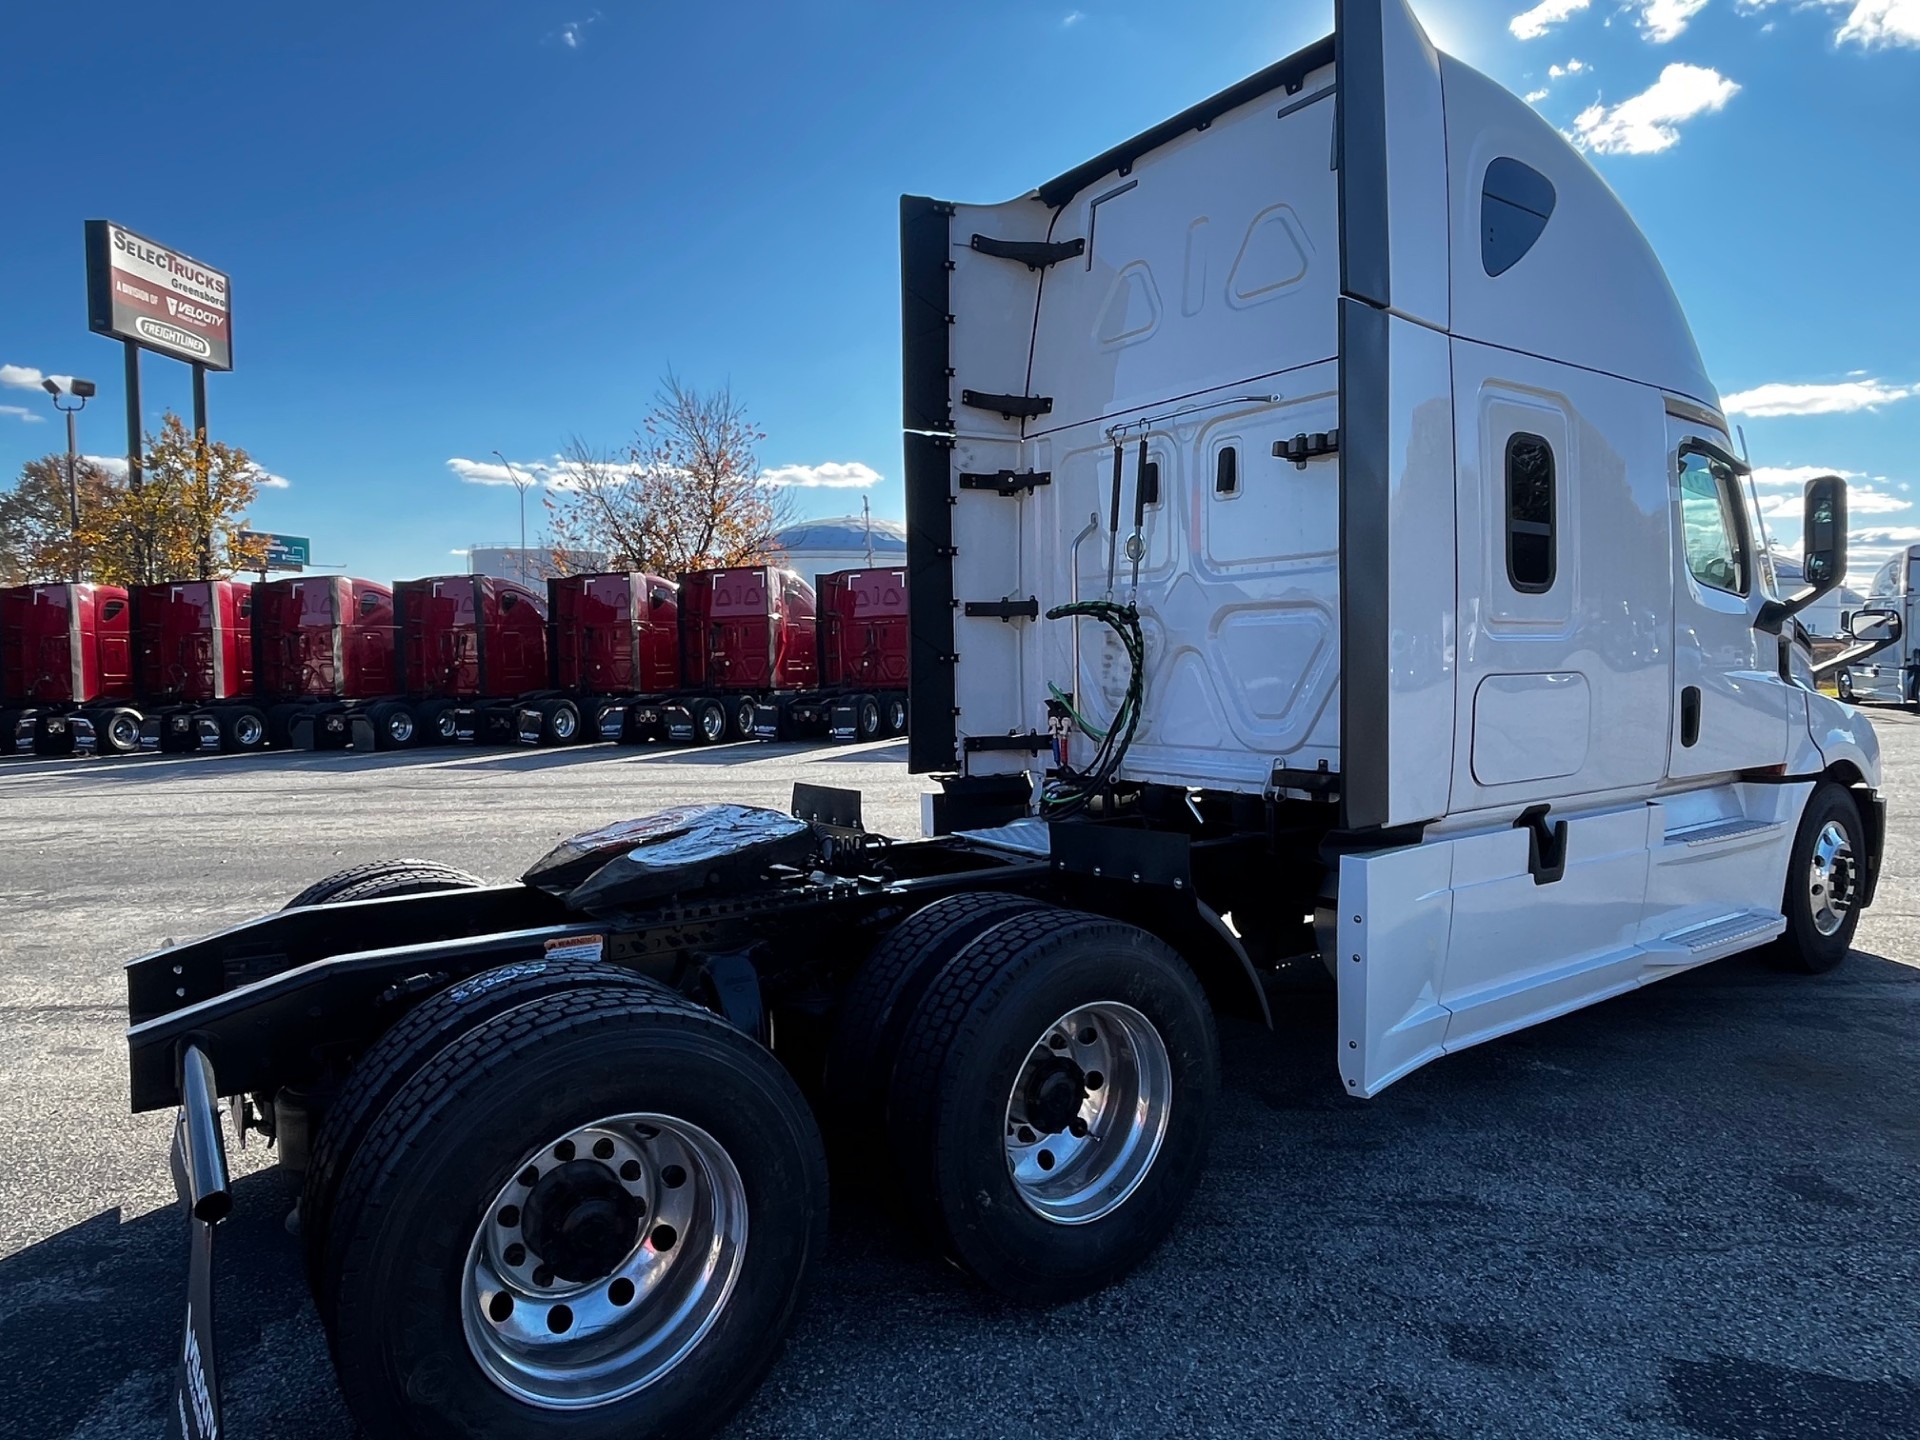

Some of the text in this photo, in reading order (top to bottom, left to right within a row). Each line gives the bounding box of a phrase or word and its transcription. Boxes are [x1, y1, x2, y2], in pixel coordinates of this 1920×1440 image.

[116, 280, 122, 292] A
[150, 294, 159, 305] OF
[171, 278, 225, 307] Greensboro
[178, 301, 224, 327] VELOCITY
[143, 322, 205, 352] FREIGHTLINER
